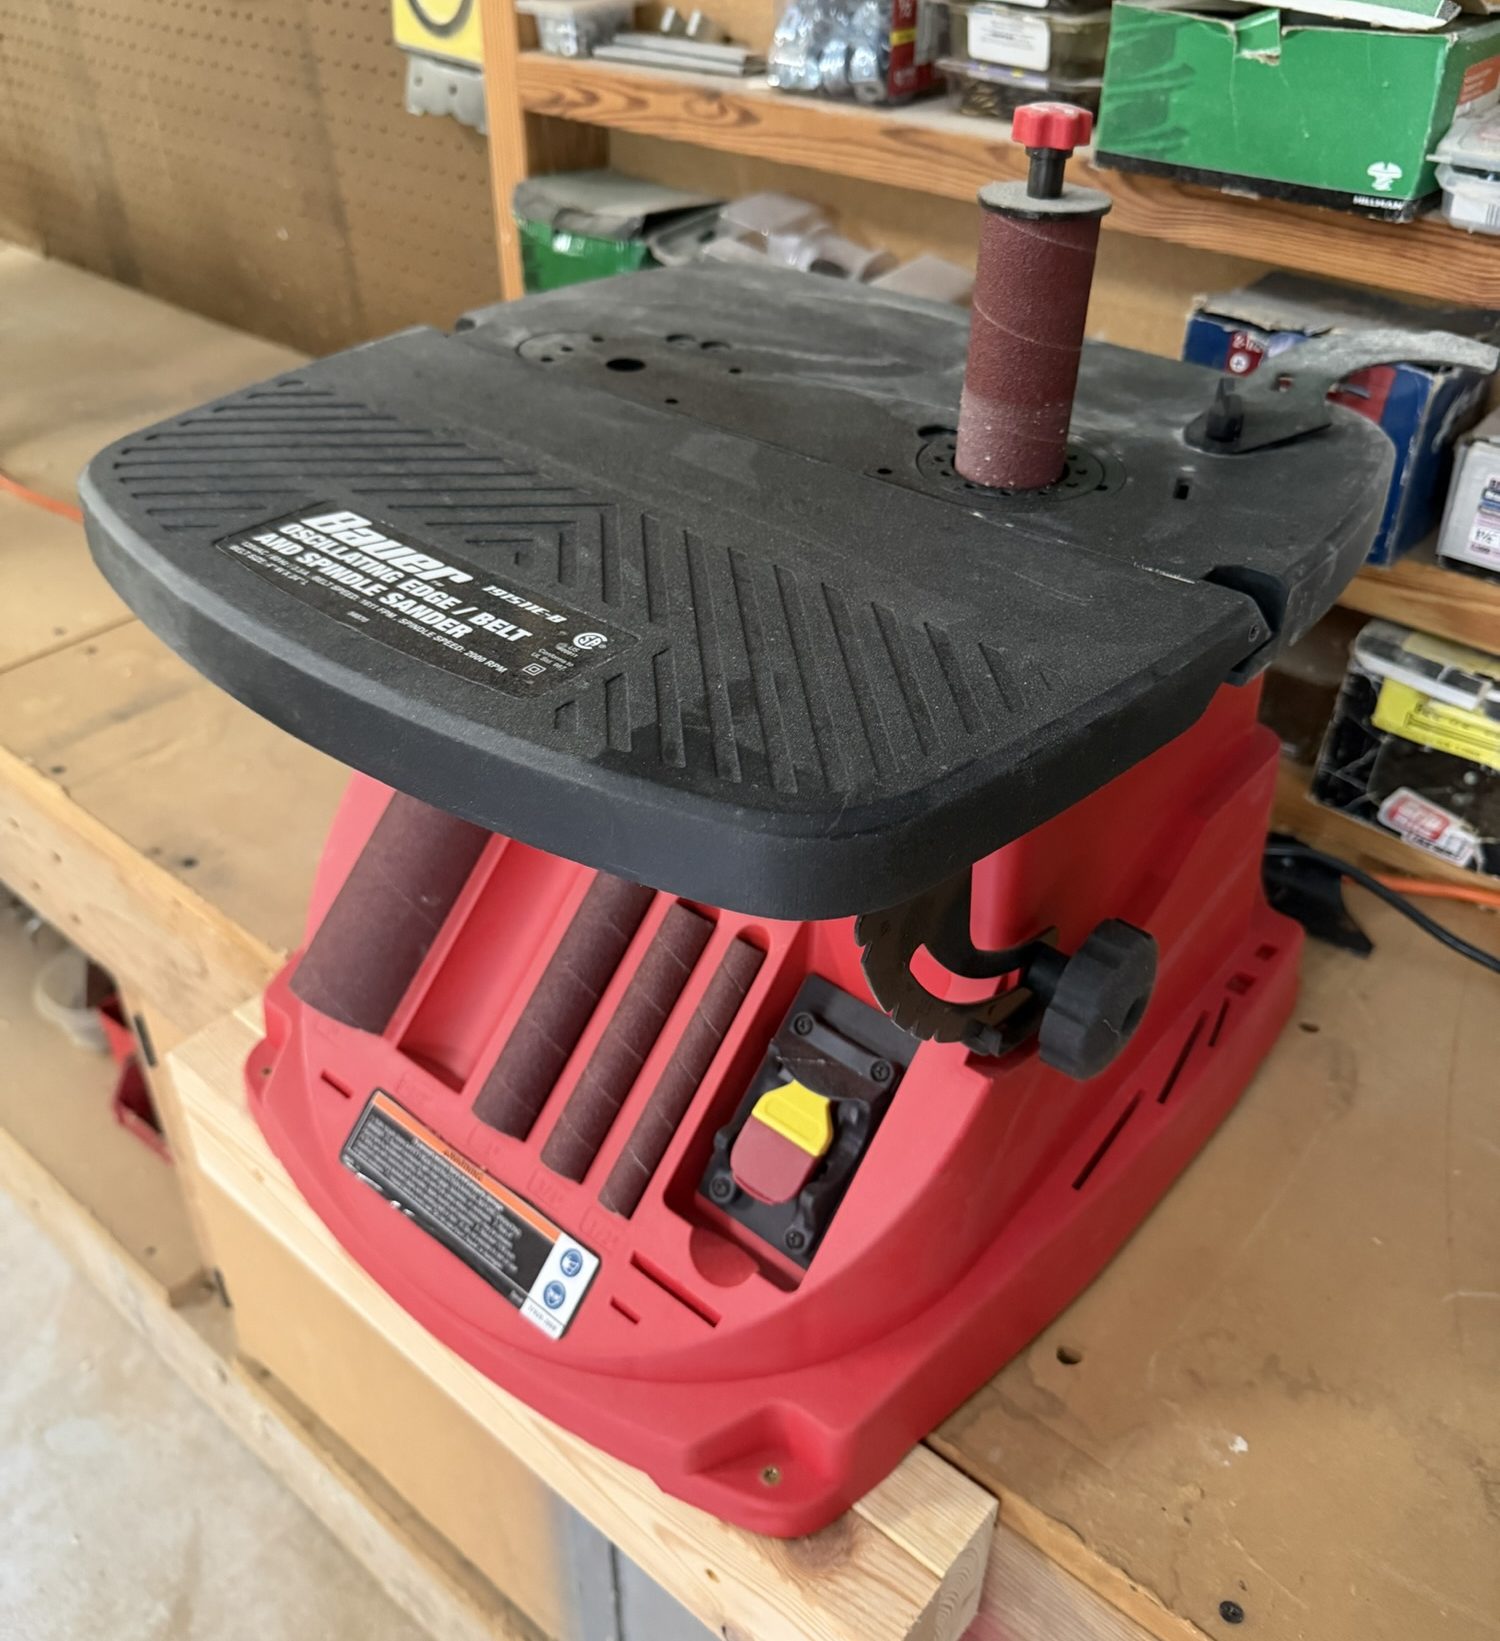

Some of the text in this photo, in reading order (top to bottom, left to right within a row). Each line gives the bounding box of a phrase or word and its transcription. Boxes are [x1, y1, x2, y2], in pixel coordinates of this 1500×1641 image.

[252, 533, 473, 638] AND SPINDLE SANDER
[279, 523, 533, 642] OSCILLATING EDGE / BELT
[301, 511, 474, 584] Bauer
[329, 584, 361, 601] SPEED:
[397, 617, 436, 638] SPINDLE
[432, 635, 466, 653] SPEED:
[464, 650, 487, 663] 2000
[484, 660, 508, 673] RPM
